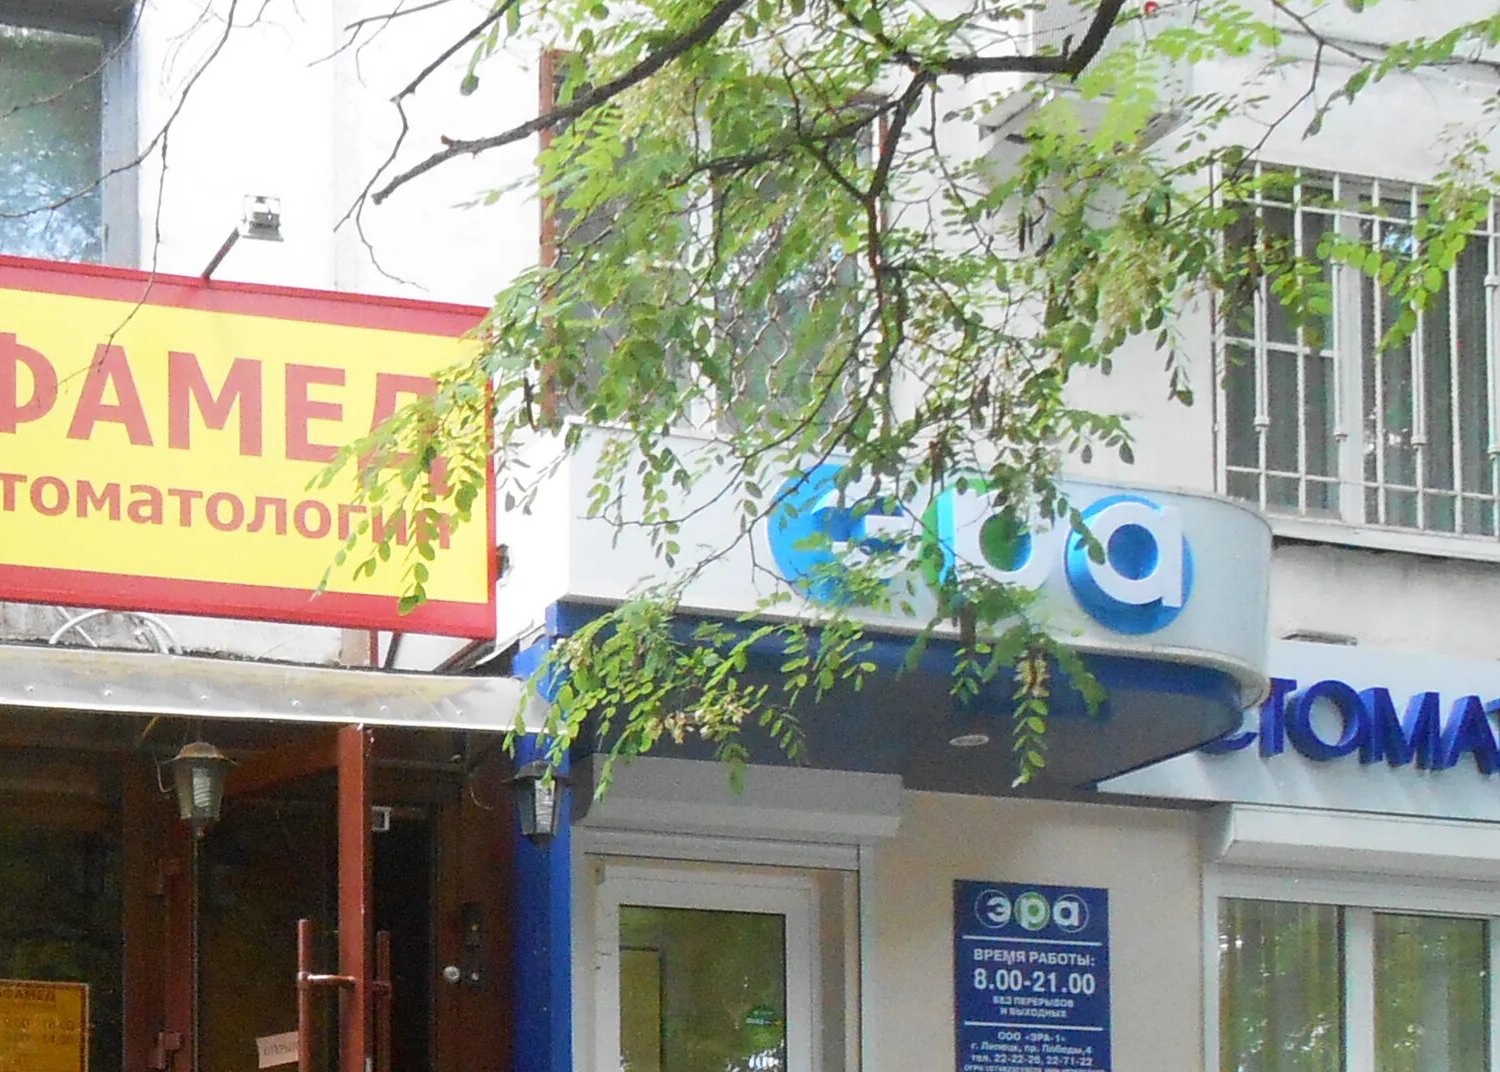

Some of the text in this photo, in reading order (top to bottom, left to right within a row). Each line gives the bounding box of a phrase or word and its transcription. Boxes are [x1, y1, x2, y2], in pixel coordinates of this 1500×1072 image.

[1197, 676, 1500, 776] ТОМА
[973, 948, 1096, 967] ВРЕМЯ РАБОТЫ:
[973, 968, 1096, 994] 8.00-21.00
[997, 1031, 1021, 1041] ООО
